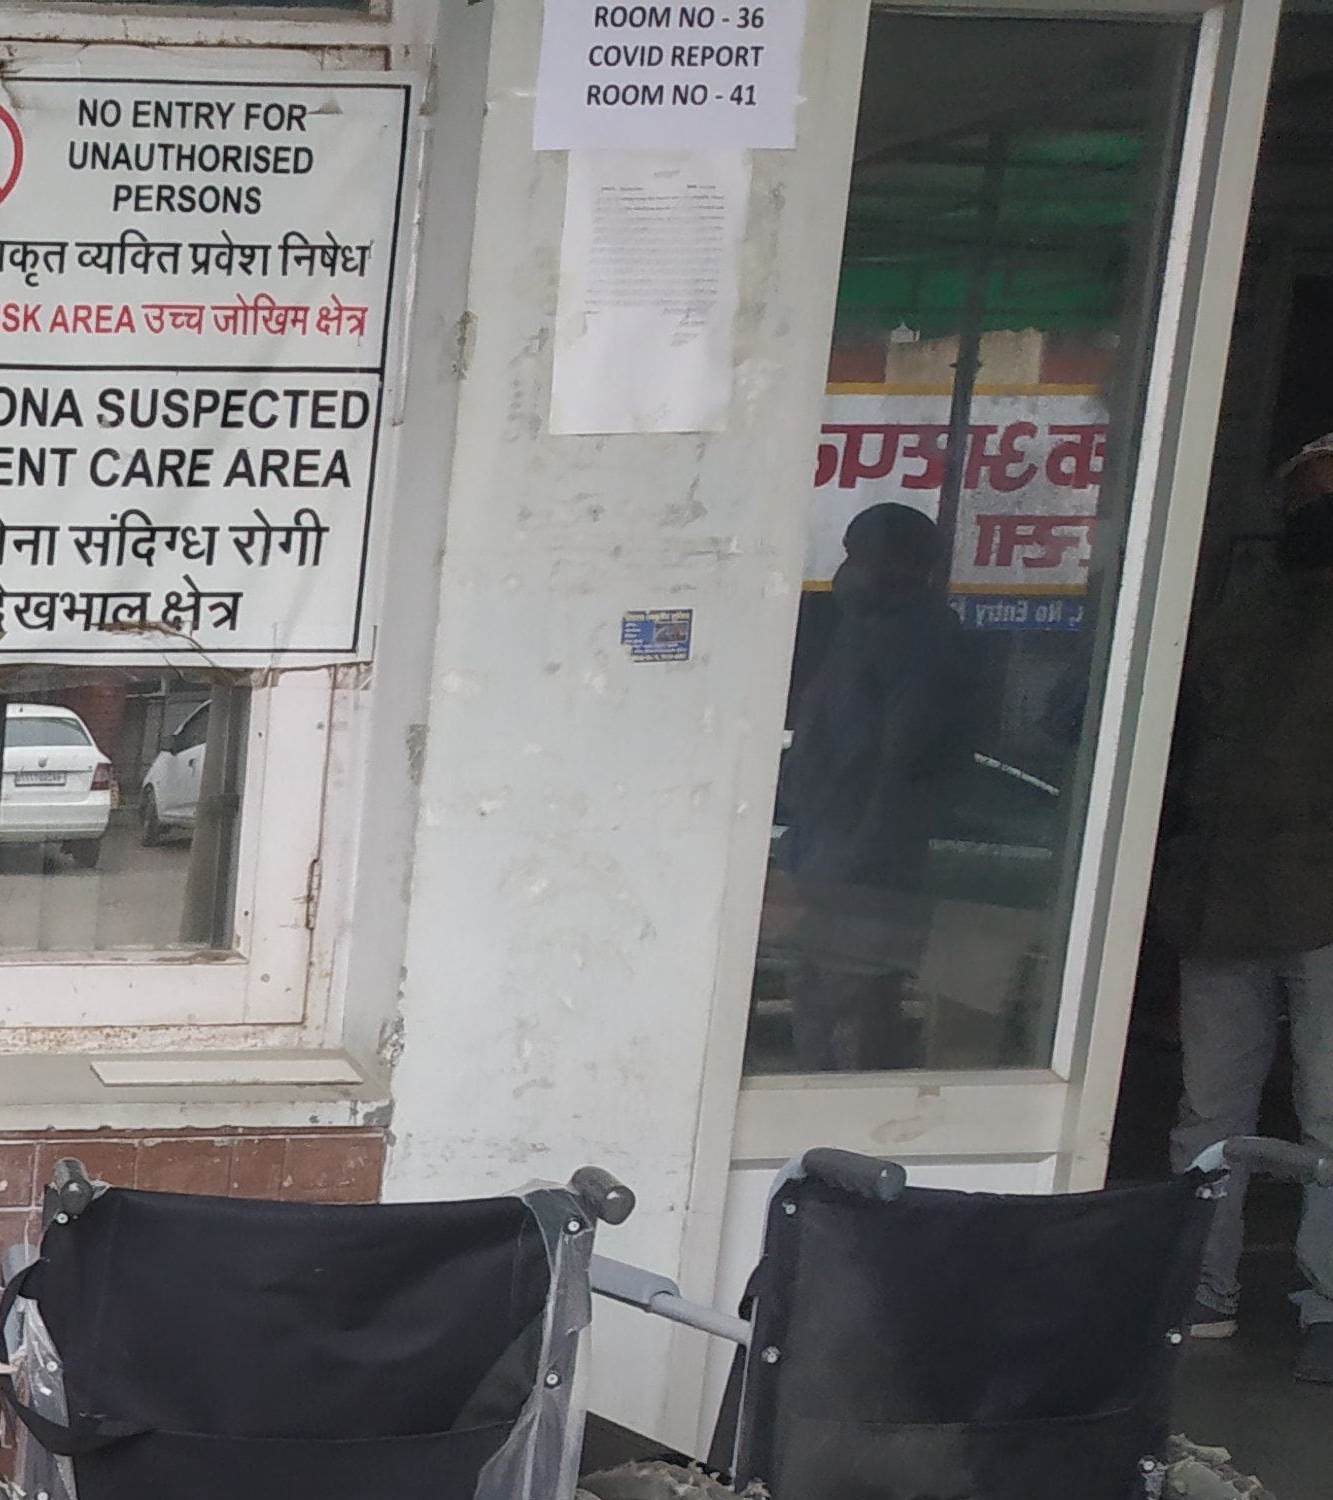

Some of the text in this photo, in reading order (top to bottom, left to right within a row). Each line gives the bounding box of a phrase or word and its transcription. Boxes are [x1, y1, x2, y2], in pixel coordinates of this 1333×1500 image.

[595, 6, 764, 28] ROOM NO 36
[589, 46, 764, 66] COVID REPORT
[587, 85, 756, 105] ROOM NO 41
[79, 99, 307, 132] NO ENTRY FOR
[69, 141, 313, 174] UNAUTHORISED
[113, 185, 261, 214] PERSONS
[75, 229, 182, 274] व्यक्ति
[188, 230, 271, 276] प्रवेश
[279, 232, 369, 278] निषेध
[49, 305, 135, 333] AREA
[142, 293, 369, 338] उच्च जोखिम क्षेत्र
[97, 388, 369, 429] SUSPECTED
[90, 448, 214, 487] CARE
[224, 449, 350, 487] AREA
[69, 509, 220, 567] संदिग्ध
[228, 508, 329, 566] रोगी
[161, 574, 243, 632] क्षेत्र
